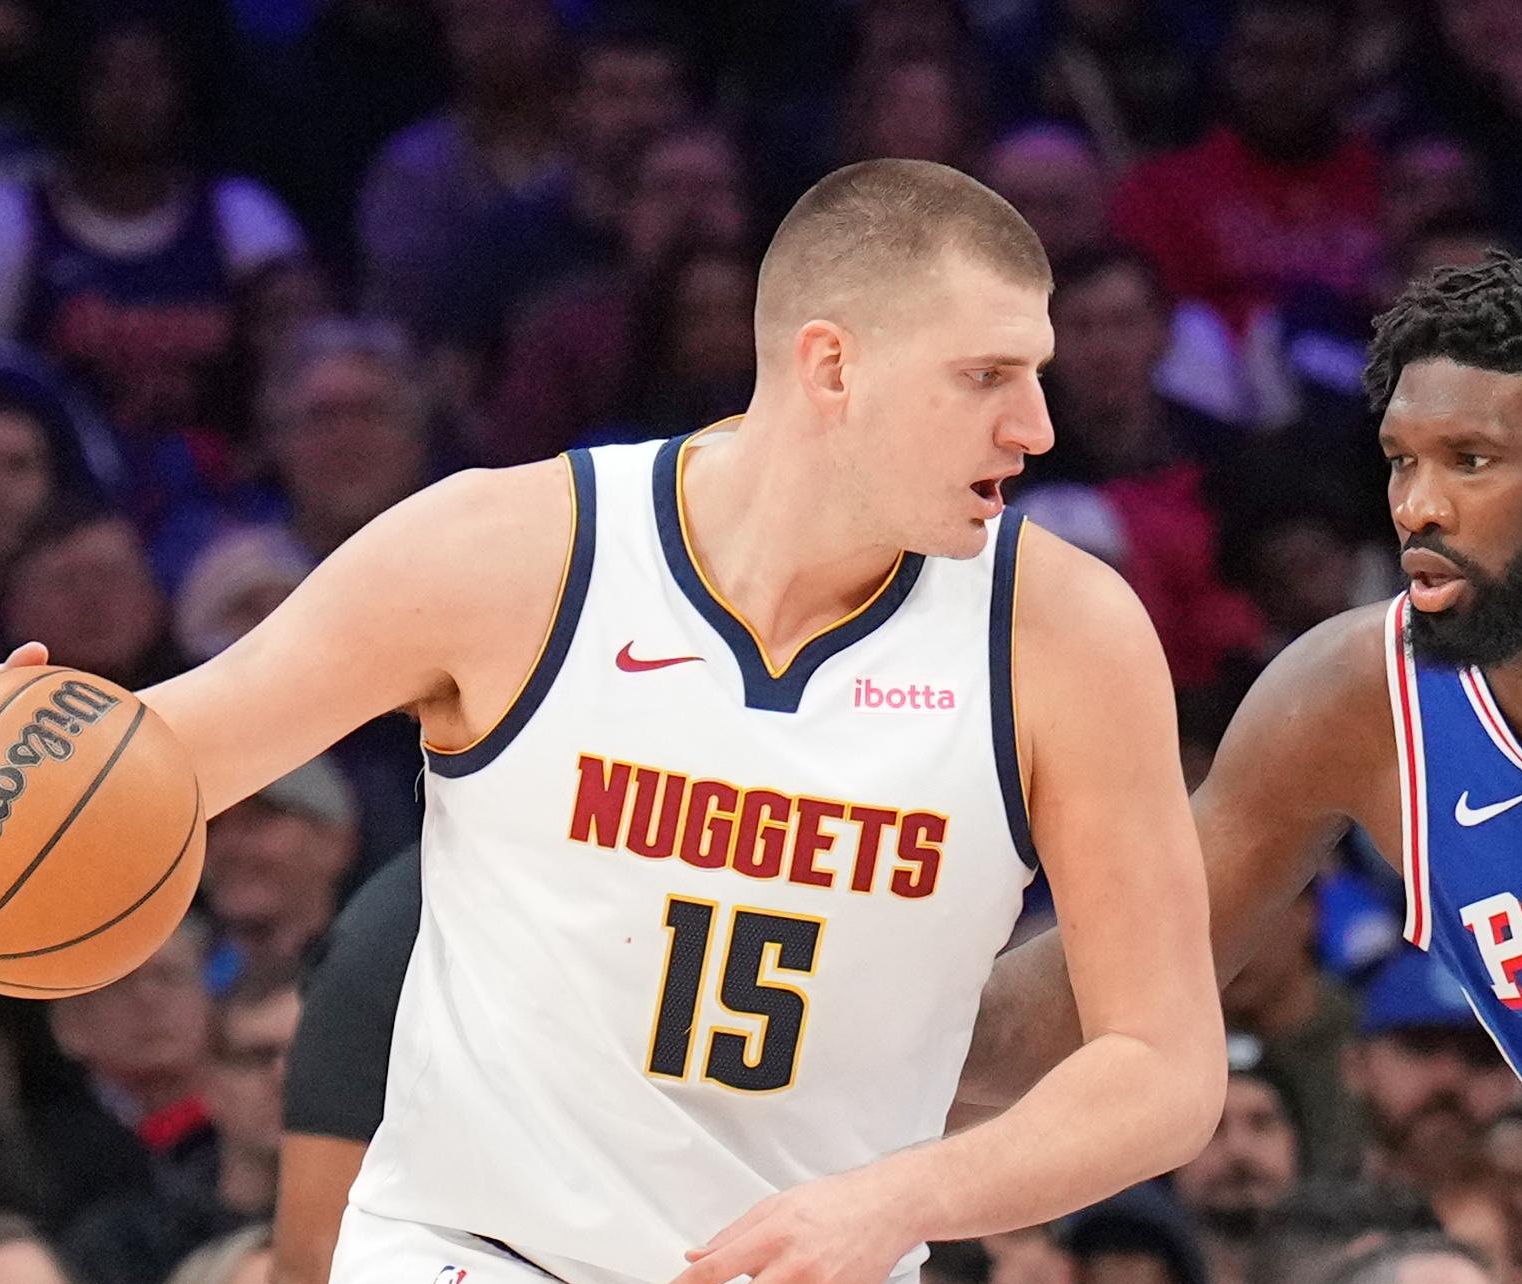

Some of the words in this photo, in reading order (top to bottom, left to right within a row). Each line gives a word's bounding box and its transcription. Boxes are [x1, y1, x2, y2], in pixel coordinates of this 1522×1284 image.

[854, 678, 956, 710] ibotta
[567, 752, 950, 900] NUGGETS
[644, 893, 827, 1095] 15
